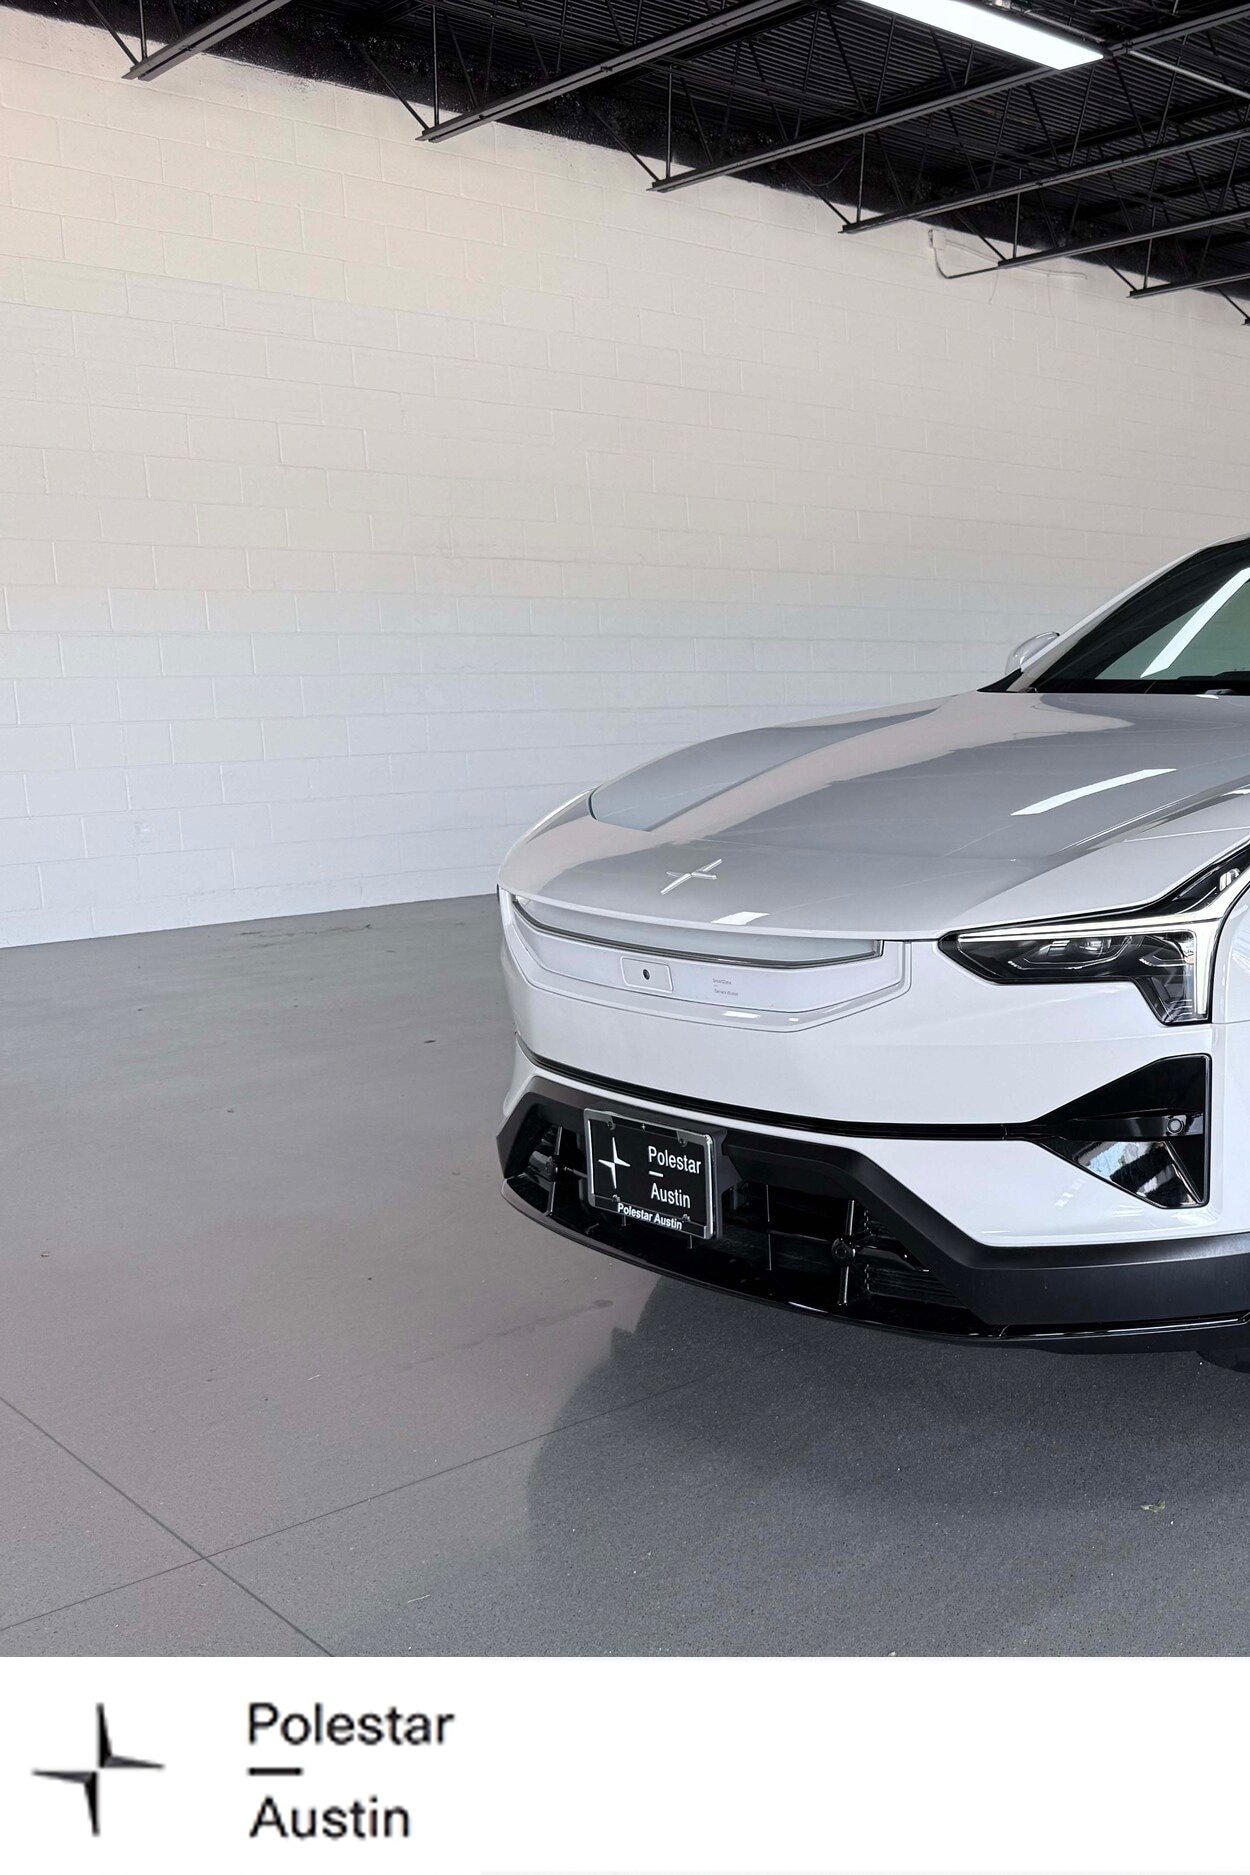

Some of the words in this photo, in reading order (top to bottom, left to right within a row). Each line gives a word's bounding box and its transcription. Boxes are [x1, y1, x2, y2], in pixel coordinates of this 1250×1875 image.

[648, 1145, 702, 1174] Polestar
[650, 1182, 691, 1209] Austin
[617, 1202, 653, 1221] Polestar
[654, 1215, 683, 1230] Austin
